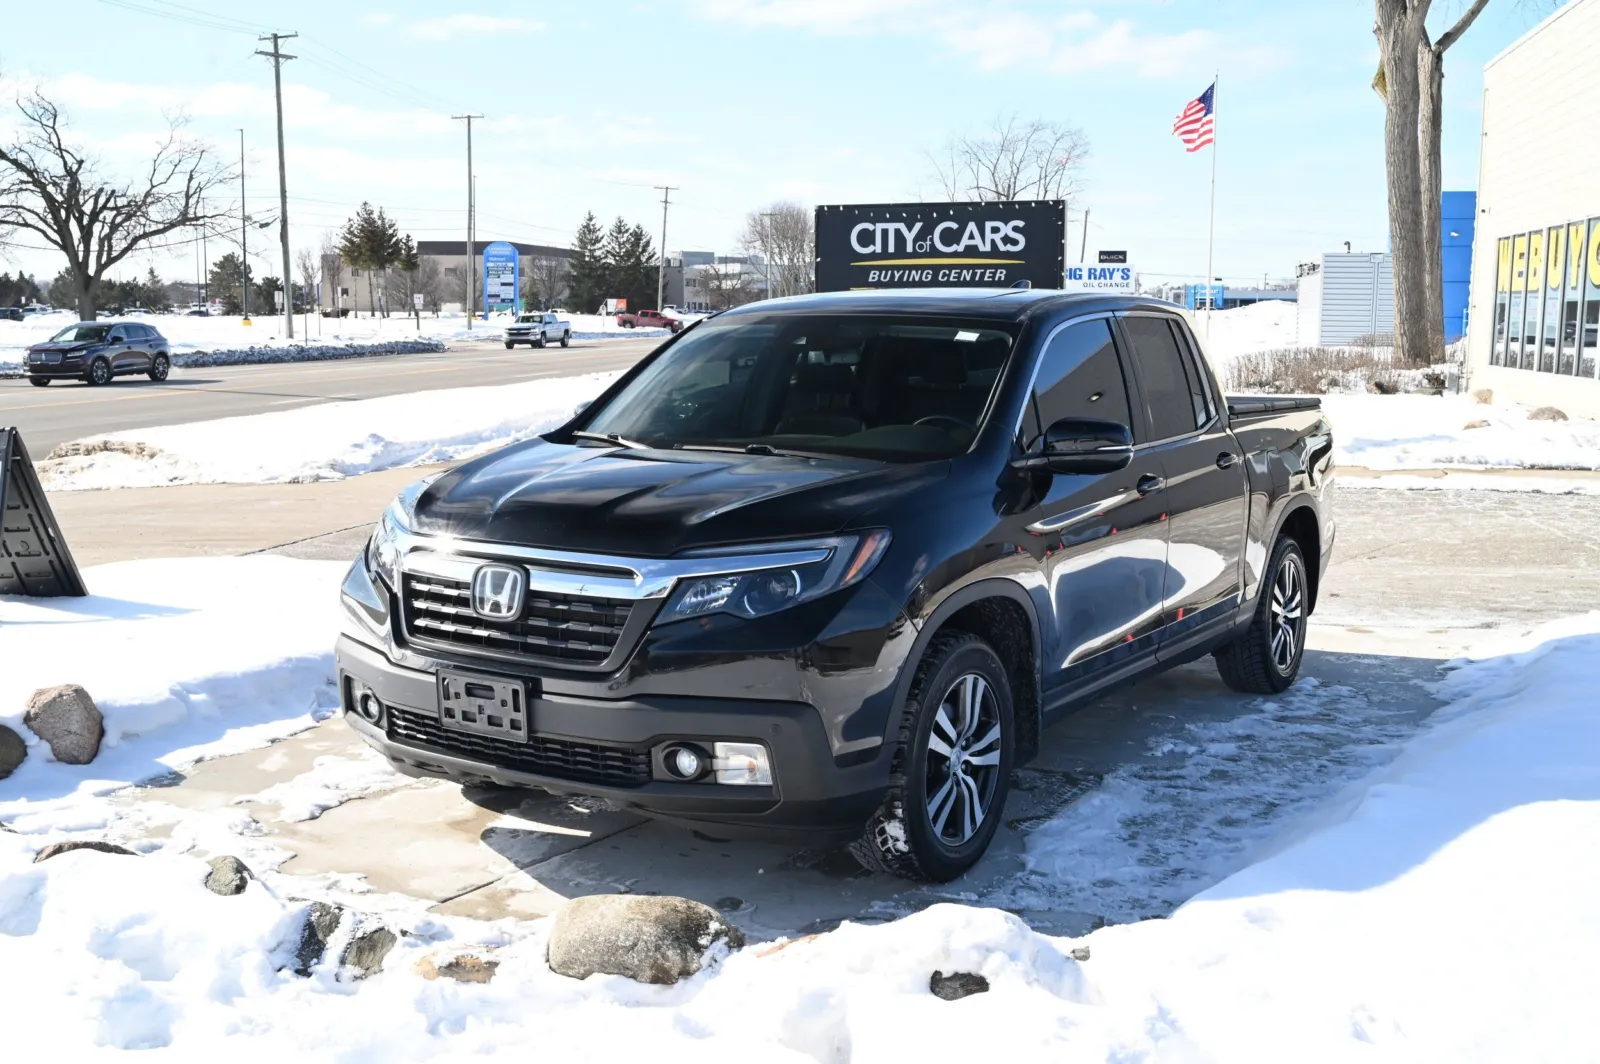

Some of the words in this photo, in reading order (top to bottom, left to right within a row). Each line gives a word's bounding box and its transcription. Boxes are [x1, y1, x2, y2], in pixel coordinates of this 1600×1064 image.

[850, 222, 923, 254] CITY
[915, 235, 932, 253] of
[933, 220, 1026, 253] CARS
[868, 269, 933, 282] BUYING
[938, 269, 1006, 282] CENTER
[1087, 267, 1131, 280] RAY'S
